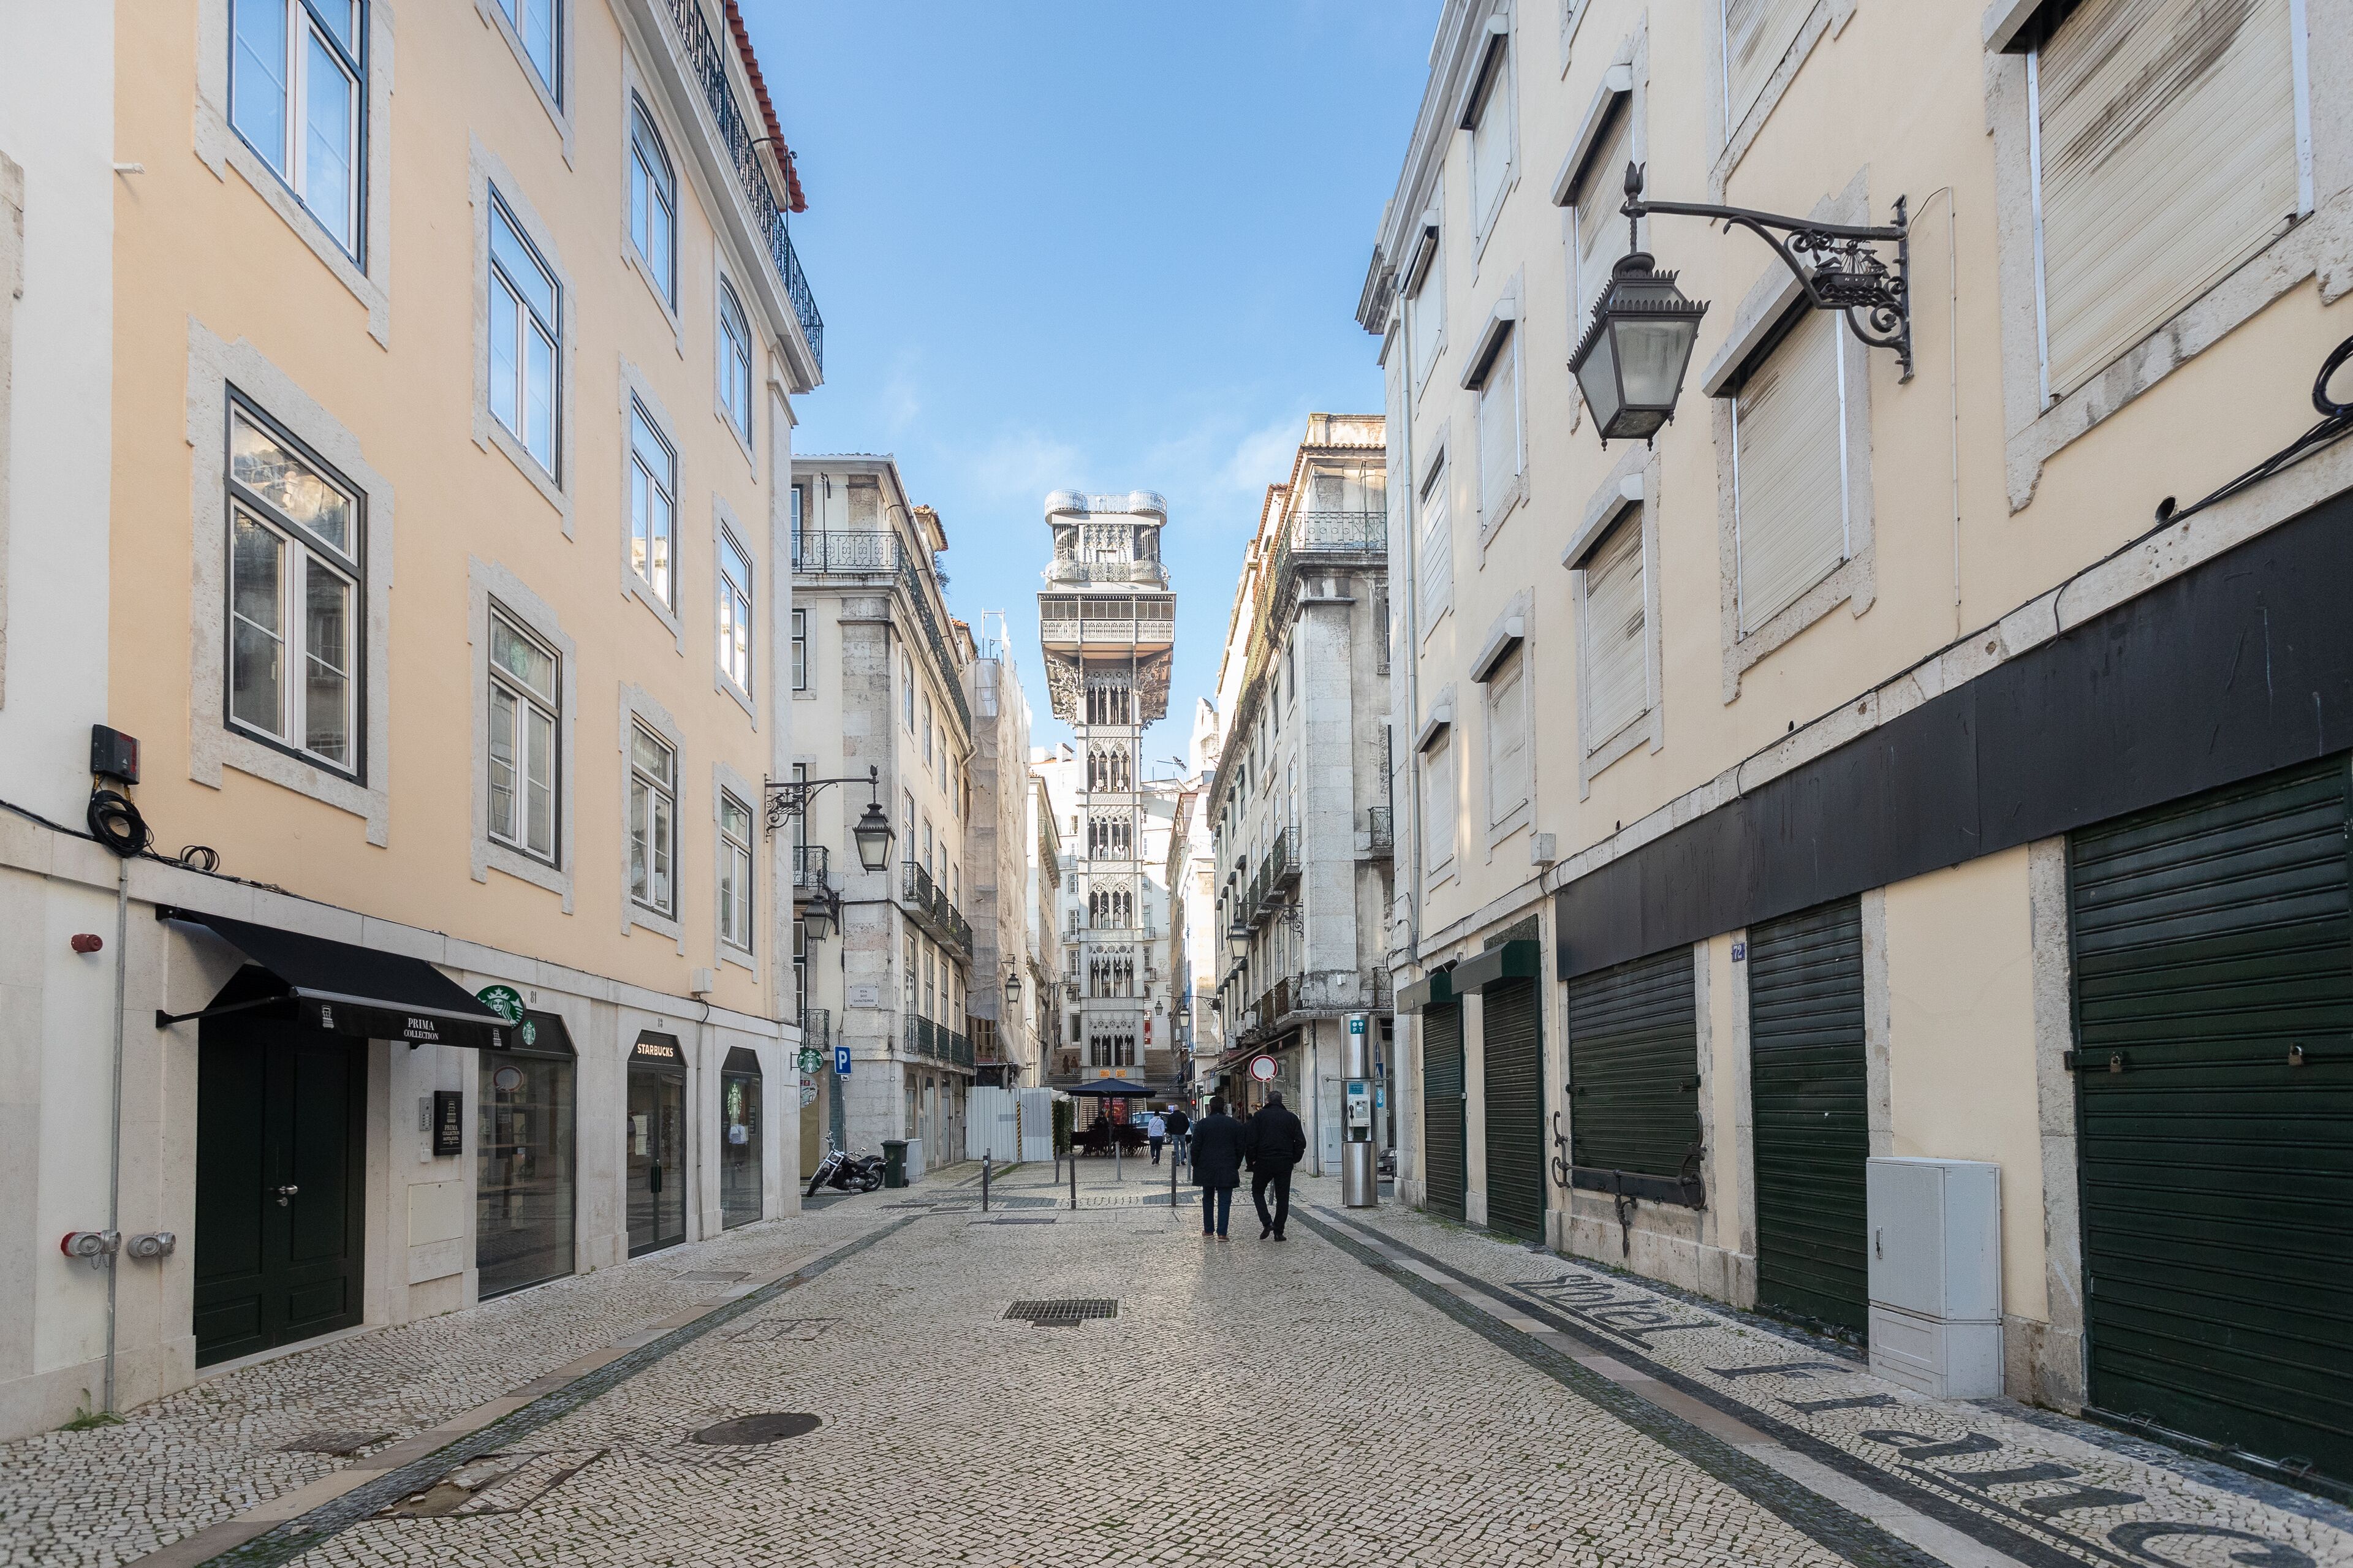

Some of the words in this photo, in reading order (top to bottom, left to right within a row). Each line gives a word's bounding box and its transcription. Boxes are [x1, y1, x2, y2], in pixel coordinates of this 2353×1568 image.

[1733, 944, 1742, 960] 72
[530, 990, 537, 1004] 81
[408, 1018, 434, 1031] PRIMA
[403, 1029, 439, 1040] COLLECTION
[637, 1043, 673, 1058] STARBUCKS
[838, 1050, 847, 1070] P
